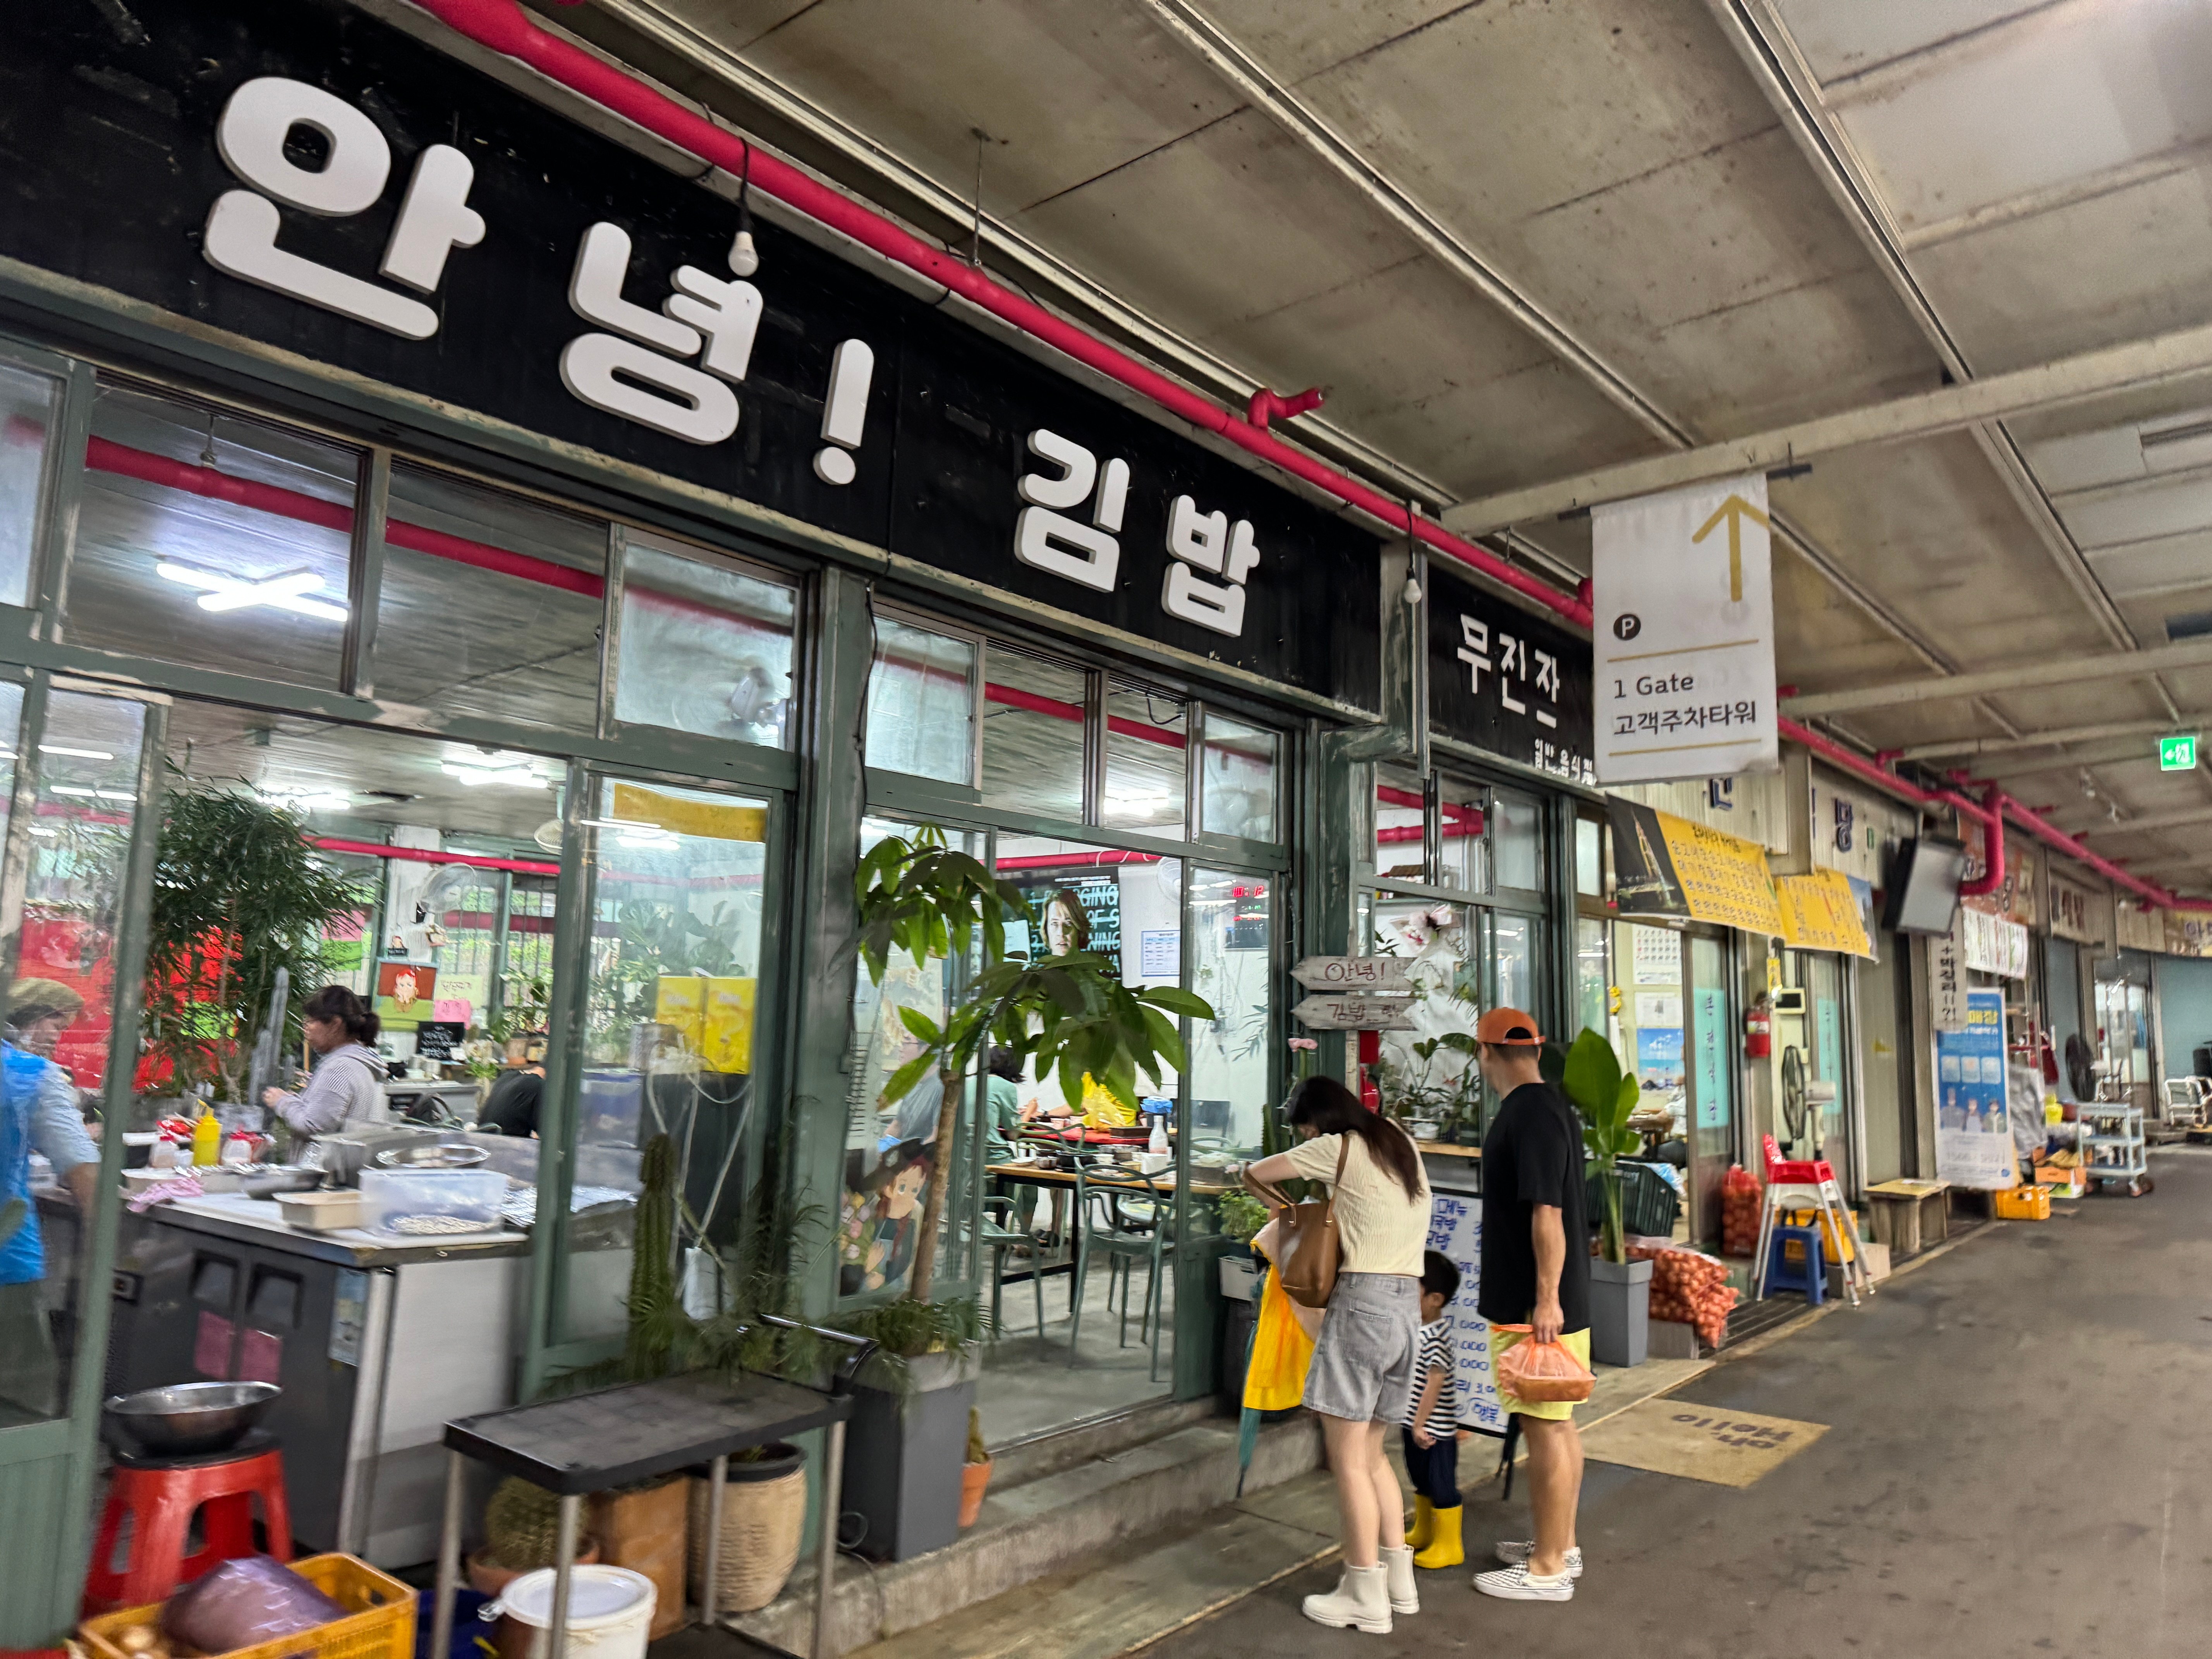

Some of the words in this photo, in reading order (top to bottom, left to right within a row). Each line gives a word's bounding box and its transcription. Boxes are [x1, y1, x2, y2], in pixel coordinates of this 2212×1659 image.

[203, 77, 874, 485] 안녕!
[1014, 429, 1261, 638] 김밥
[1614, 680, 1626, 699] 1
[1636, 673, 1693, 696] Gate
[1614, 701, 1756, 735] 고객주차타워
[1325, 961, 1385, 982] 안녕!
[1327, 1002, 1366, 1021] 김밥
